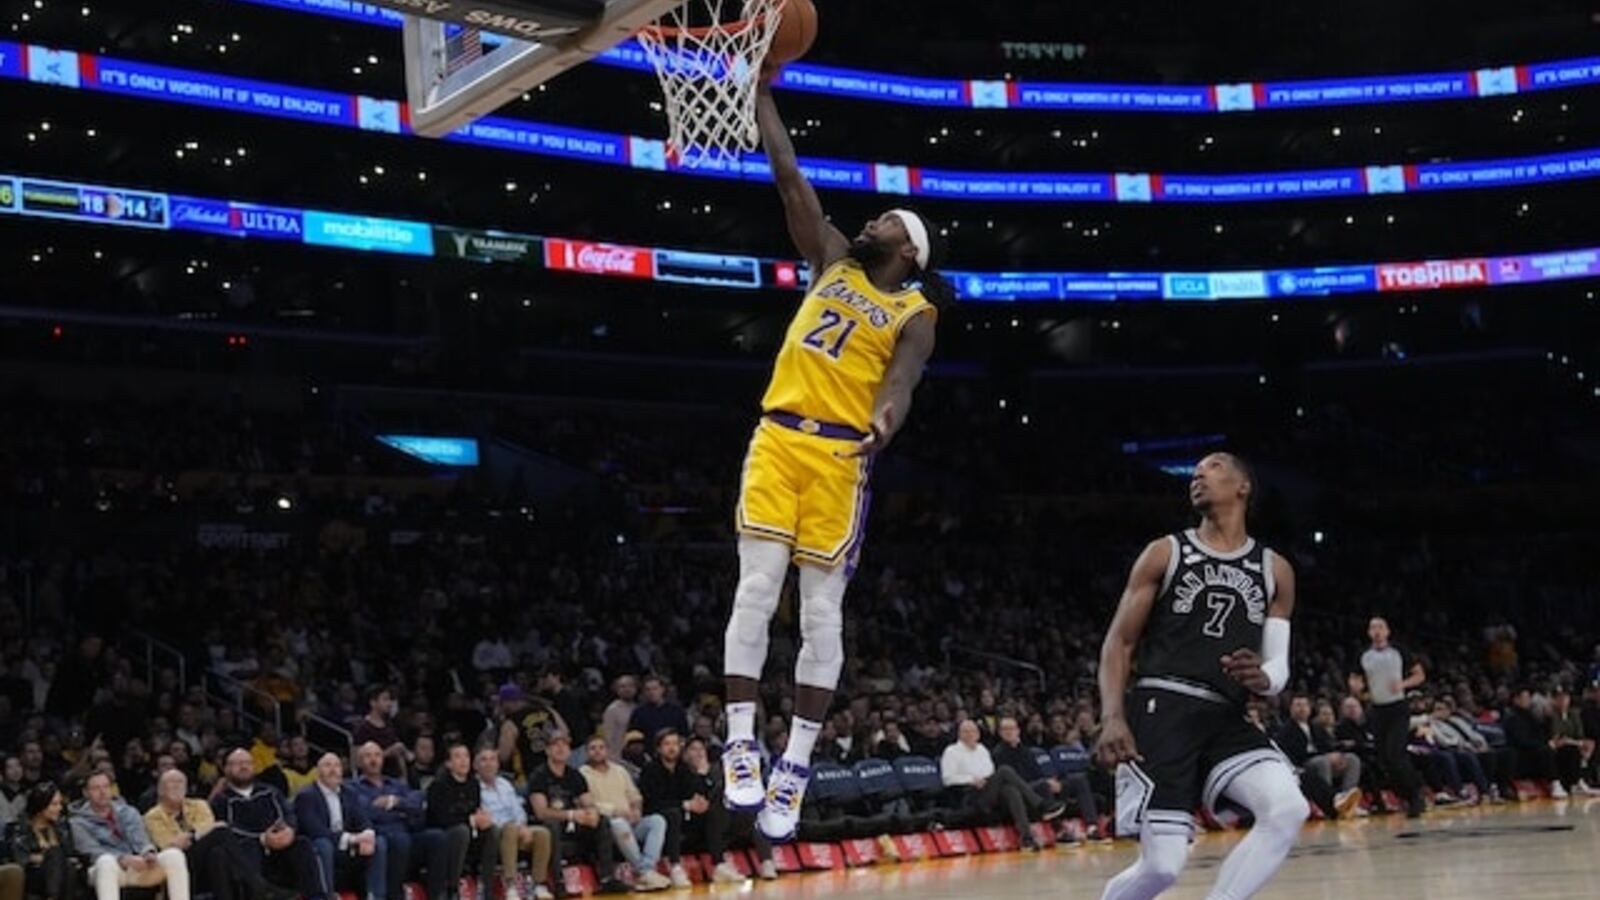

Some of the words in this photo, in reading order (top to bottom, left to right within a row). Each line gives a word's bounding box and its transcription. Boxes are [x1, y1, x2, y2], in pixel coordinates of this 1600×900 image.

[241, 212, 300, 234] ULTRA
[1297, 274, 1366, 289] crypto.com
[1382, 262, 1483, 287] TOSHIBA
[985, 281, 1049, 294] crypto.com
[802, 309, 857, 359] 21
[1172, 570, 1206, 614] SAN
[1203, 592, 1236, 639] 7
